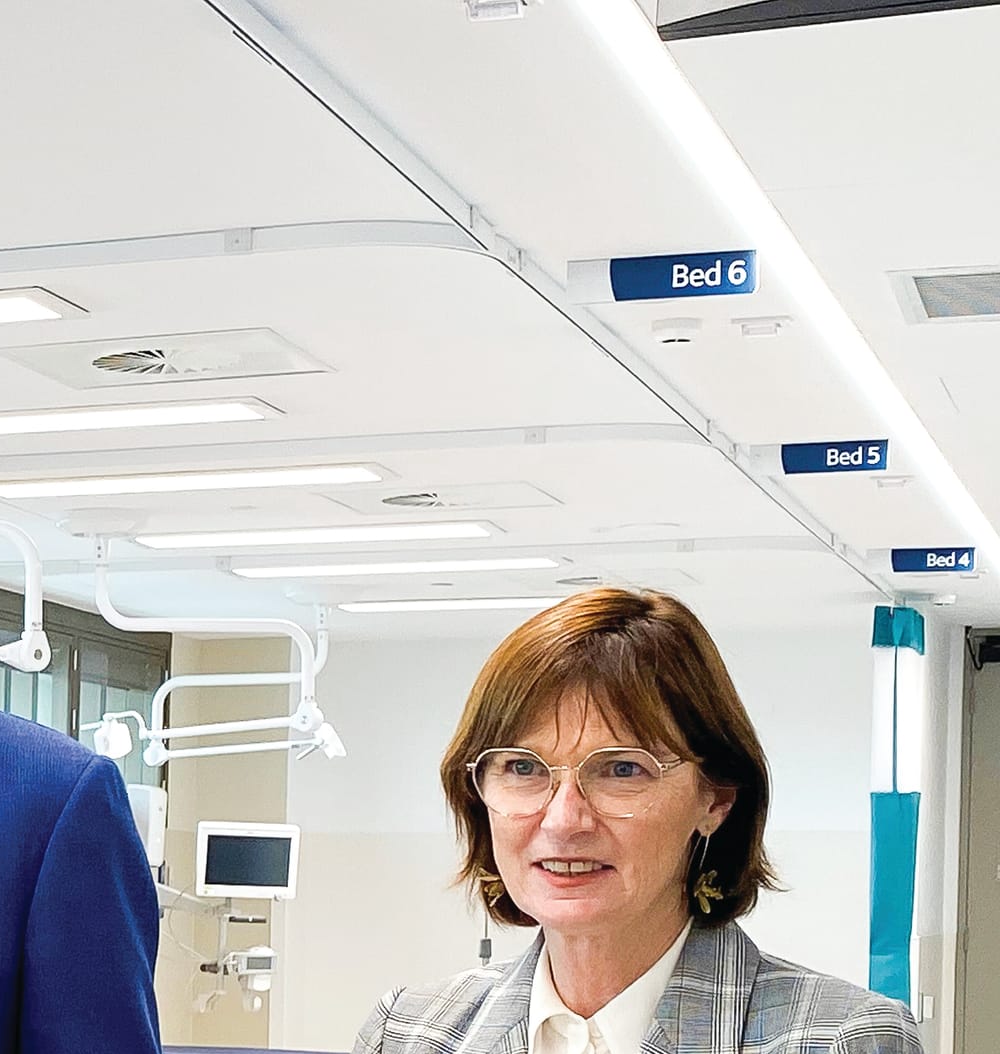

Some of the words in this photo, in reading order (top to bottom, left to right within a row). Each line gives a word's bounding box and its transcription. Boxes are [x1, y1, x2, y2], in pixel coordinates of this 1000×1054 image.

[672, 260, 721, 288] Bed
[727, 260, 747, 285] 6
[826, 447, 863, 466] Bed
[867, 446, 881, 464] 5
[926, 552, 955, 567] Bed
[958, 552, 970, 567] 4
